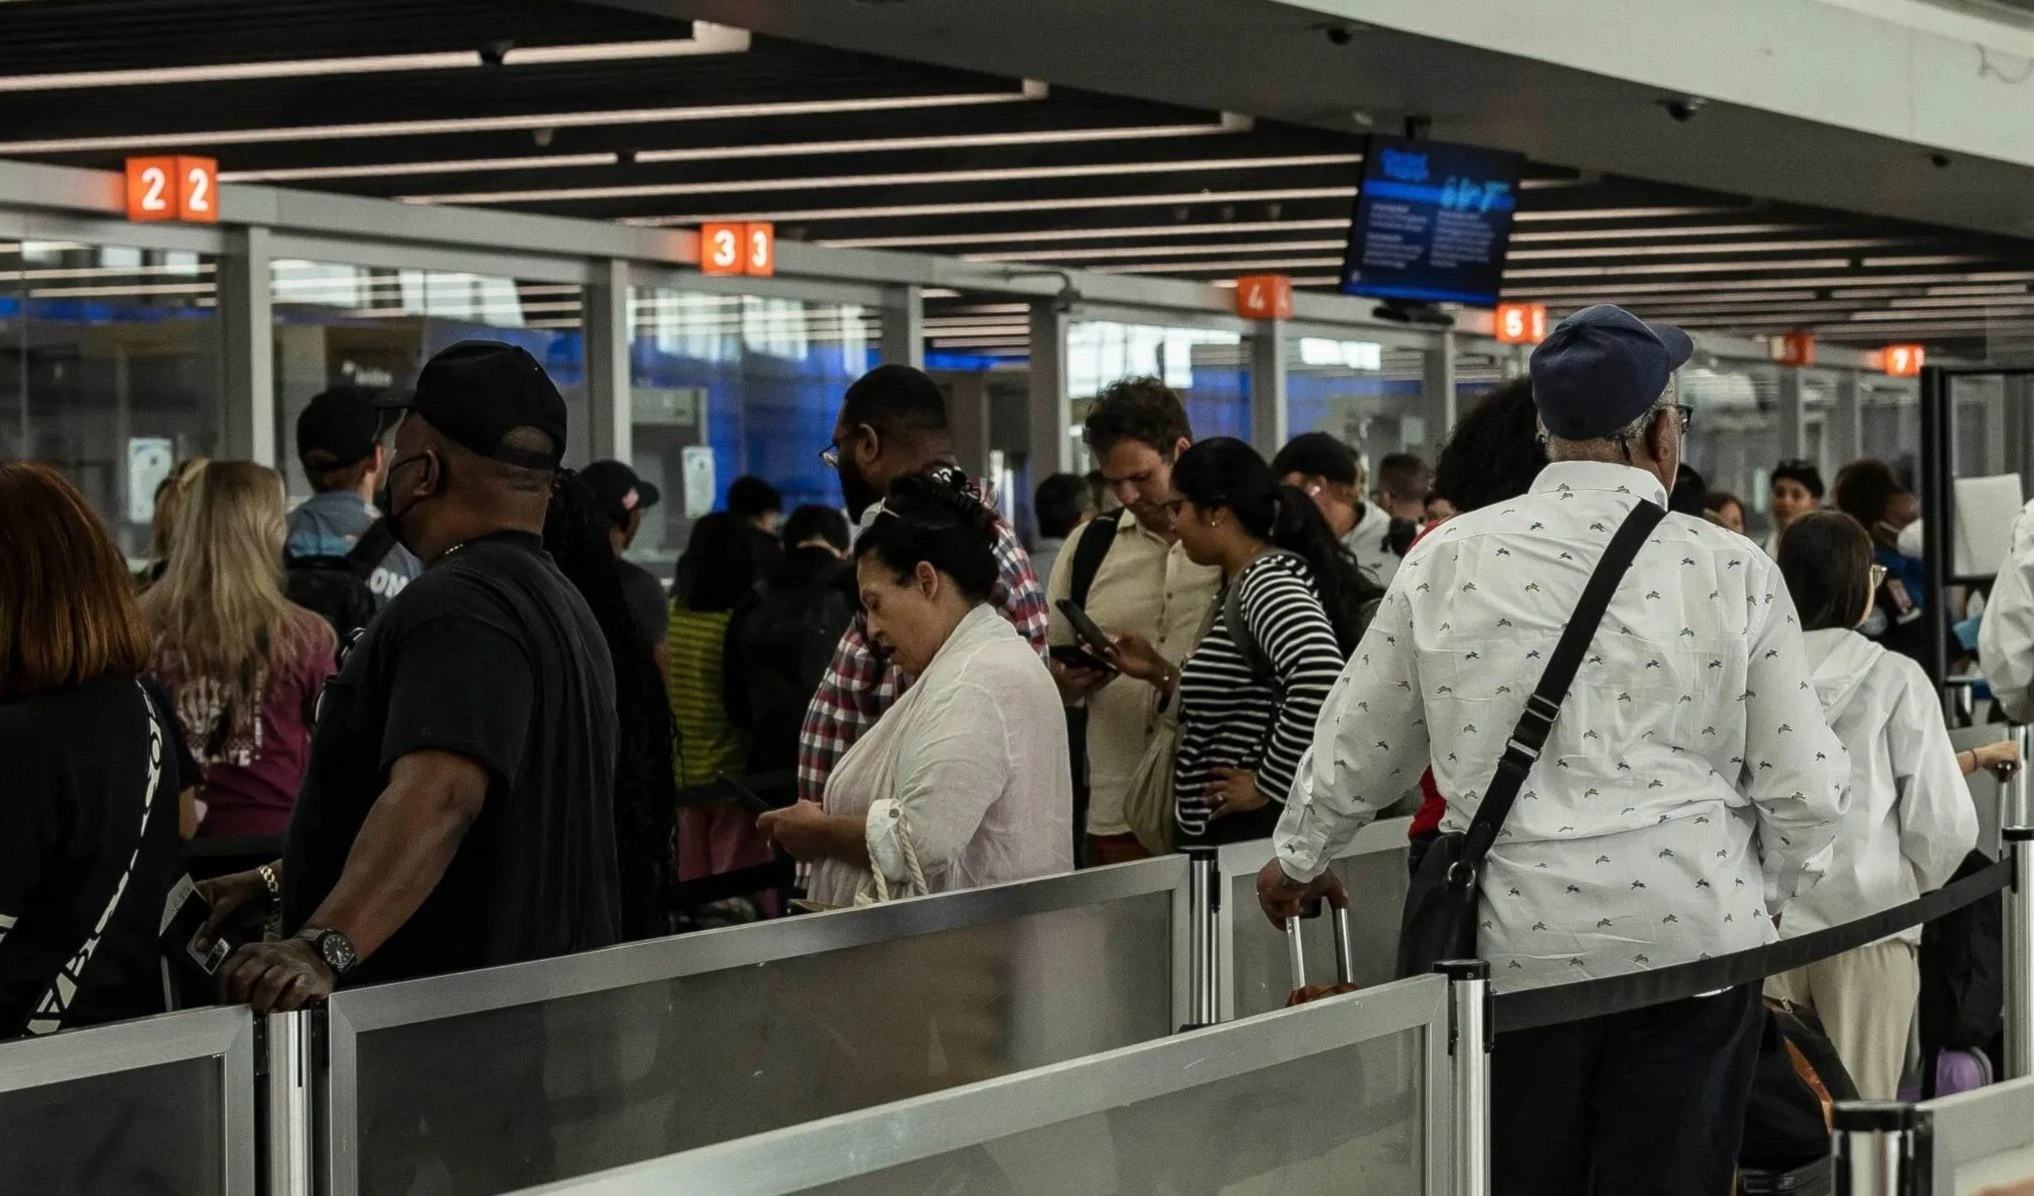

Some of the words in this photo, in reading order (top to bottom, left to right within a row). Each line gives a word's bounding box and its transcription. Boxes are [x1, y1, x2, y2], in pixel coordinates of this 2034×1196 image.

[141, 166, 166, 211] 2
[188, 167, 209, 211] 2
[713, 229, 736, 267] 3
[751, 230, 768, 268] 3
[1247, 283, 1265, 310] 4
[1505, 309, 1524, 337] 5
[1892, 347, 1909, 373] 7
[365, 567, 409, 599] ON
